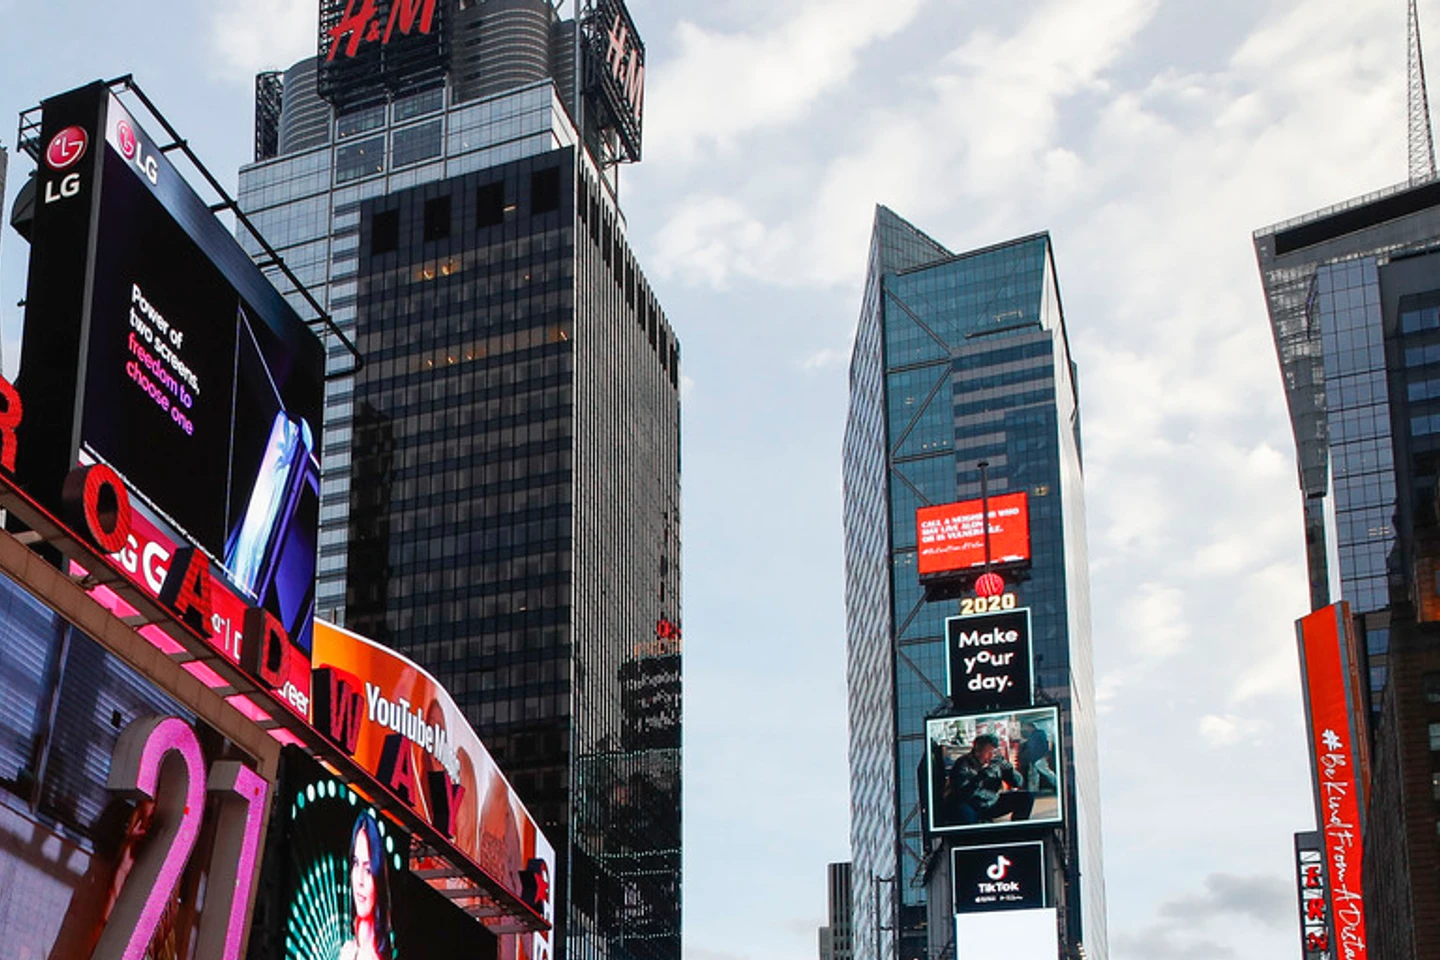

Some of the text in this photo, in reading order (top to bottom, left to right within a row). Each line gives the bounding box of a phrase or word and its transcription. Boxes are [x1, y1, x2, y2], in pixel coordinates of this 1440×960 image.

[136, 141, 158, 186] LG
[45, 173, 80, 203] LG
[131, 283, 183, 349] Power of
[129, 306, 200, 395] two screens,
[128, 332, 192, 409] freedom to
[126, 361, 194, 436] choose one
[951, 512, 996, 523] NEIGHBR
[961, 592, 1016, 615] 2020
[959, 627, 1020, 648] Make
[964, 650, 1014, 674] your
[967, 673, 1013, 693] day.
[365, 682, 434, 753] YouTube
[977, 881, 1020, 893] TikTok
